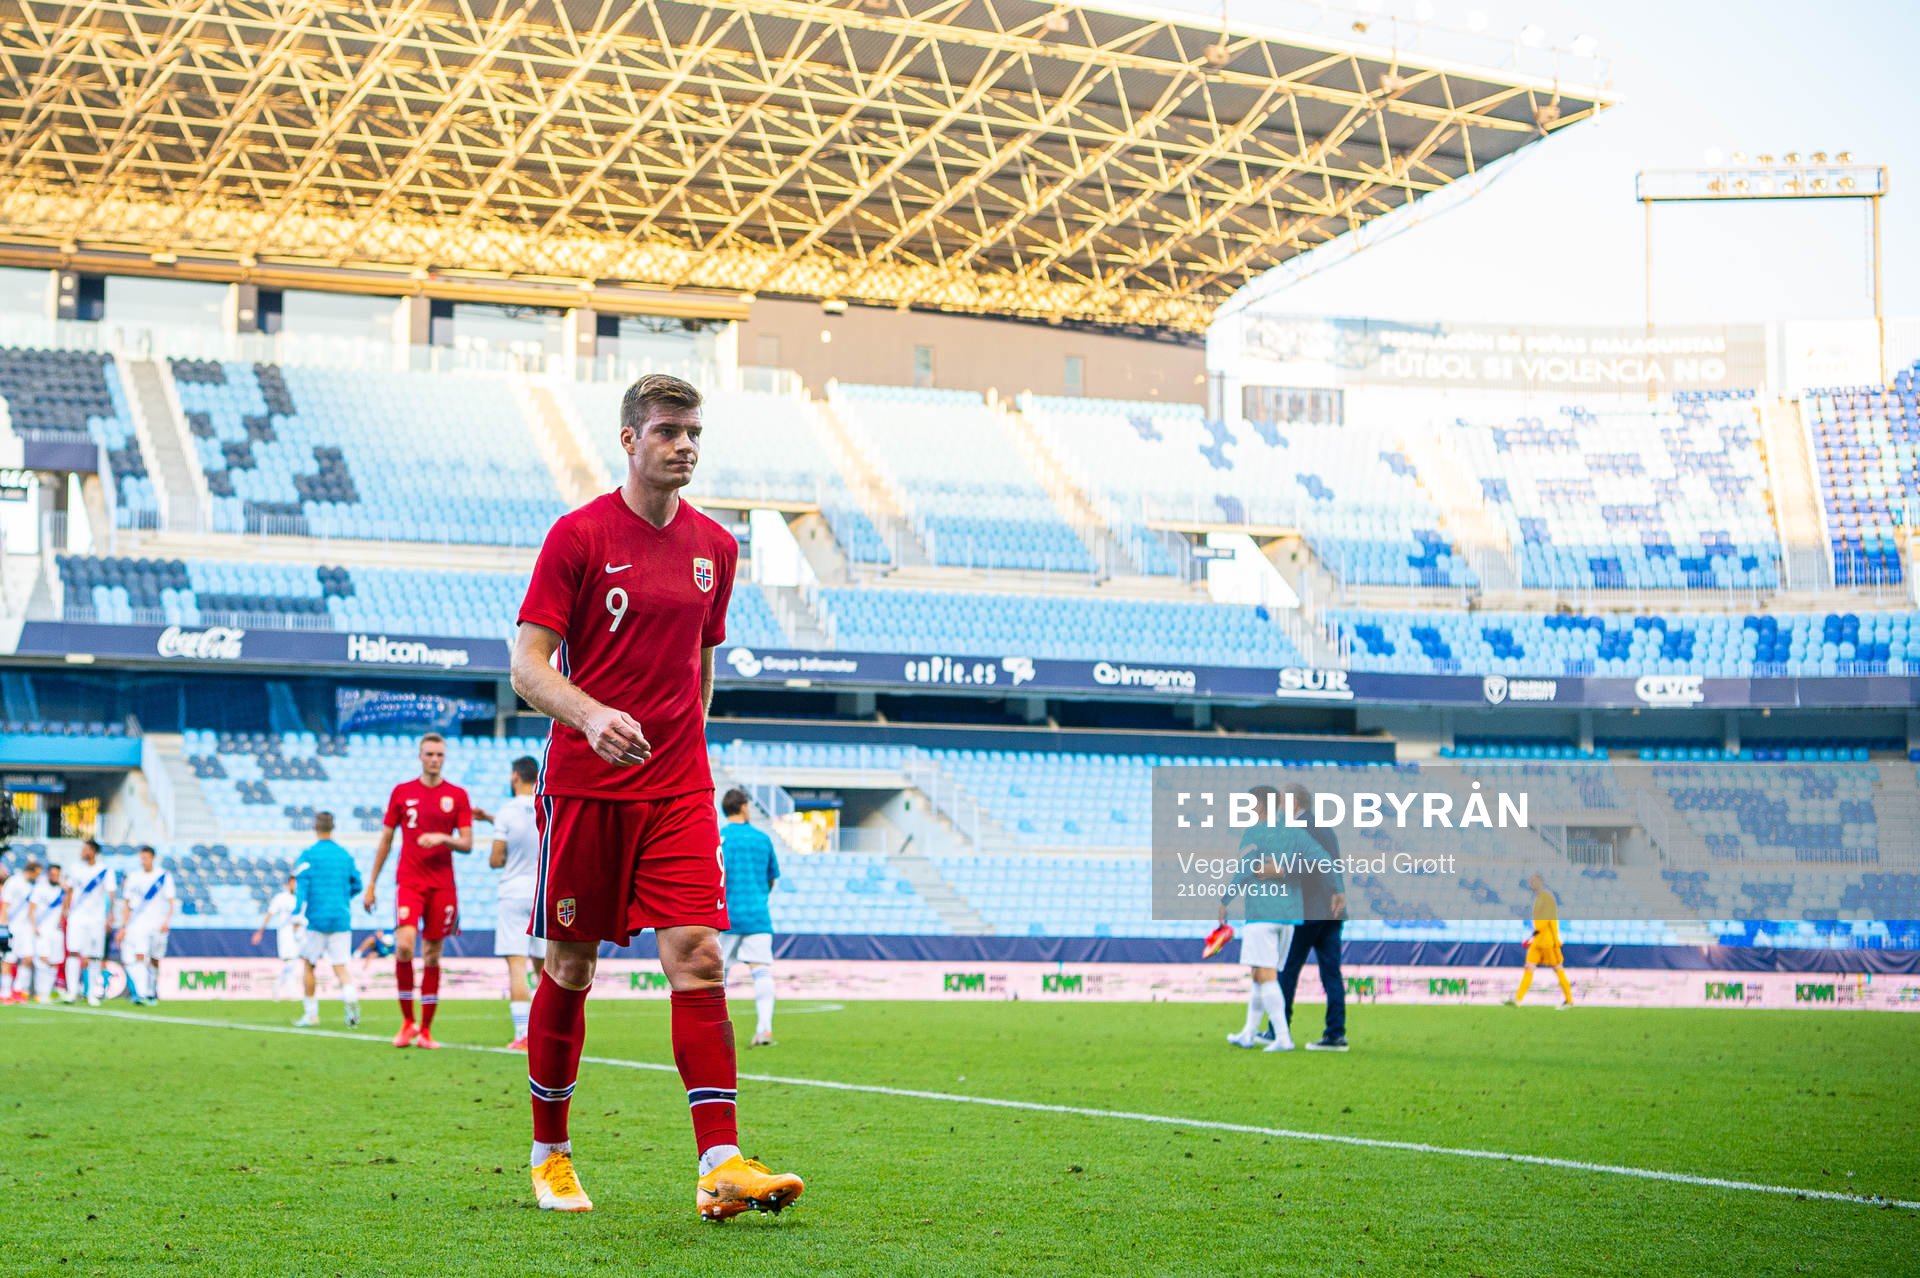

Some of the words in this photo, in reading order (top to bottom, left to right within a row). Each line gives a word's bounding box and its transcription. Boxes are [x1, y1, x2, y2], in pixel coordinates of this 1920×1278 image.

[1518, 356, 1666, 384] VIOLENCIA
[1673, 358, 1727, 384] NO
[605, 587, 629, 632] 9
[1278, 667, 1350, 691] SUR
